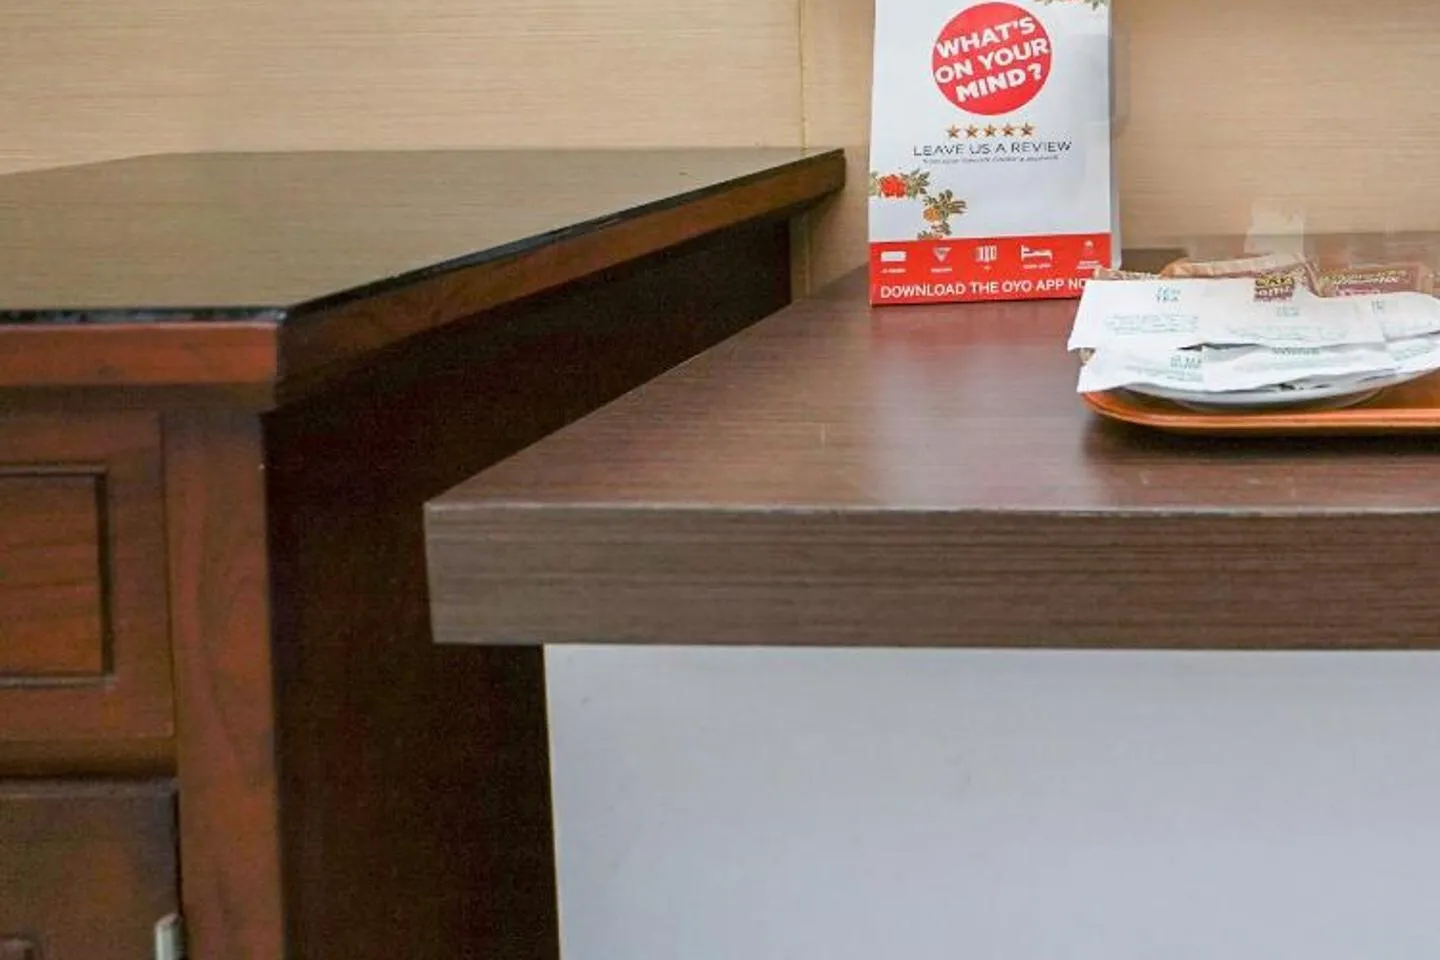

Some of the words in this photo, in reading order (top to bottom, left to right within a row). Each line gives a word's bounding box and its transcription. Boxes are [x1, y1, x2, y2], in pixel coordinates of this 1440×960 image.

[936, 16, 1036, 59] WHAT'S
[935, 58, 975, 84] ON
[977, 37, 1049, 71] YOUR
[913, 143, 964, 157] LEAVE
[969, 142, 991, 155] US
[995, 142, 1007, 154] A
[1011, 140, 1072, 153] REVIEW
[880, 283, 966, 299] DOWNLOAD
[971, 281, 999, 295] THE
[1001, 280, 1033, 293] OYO
[1036, 279, 1065, 292] APP
